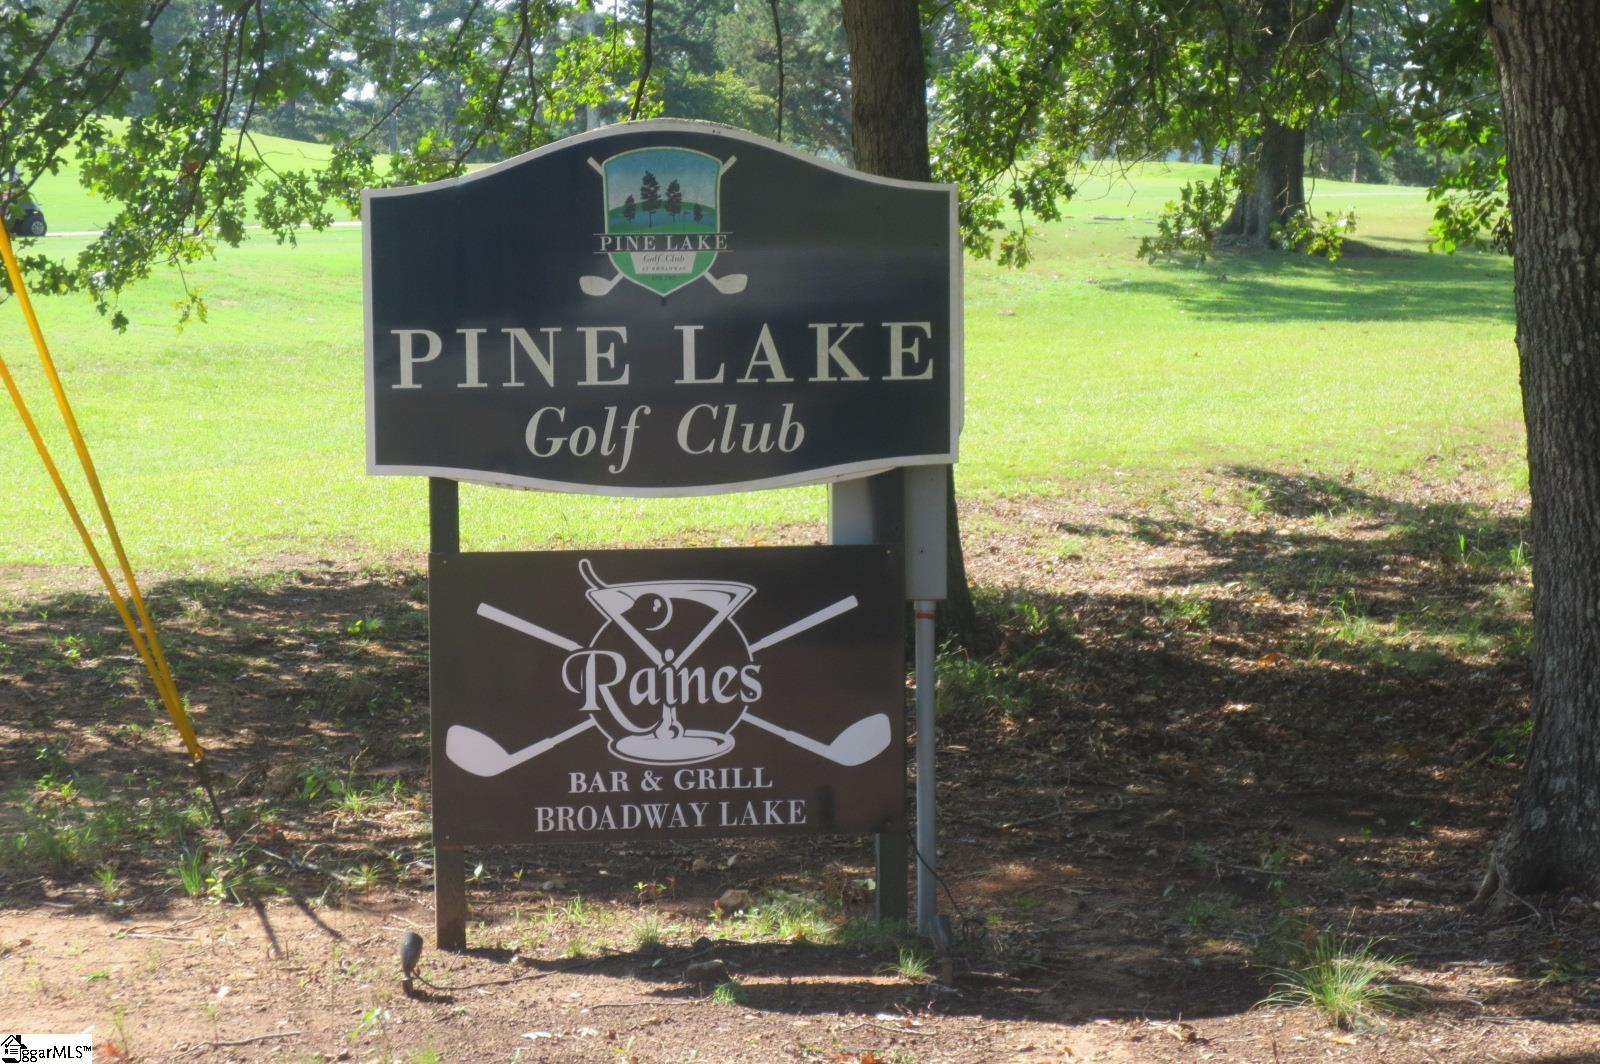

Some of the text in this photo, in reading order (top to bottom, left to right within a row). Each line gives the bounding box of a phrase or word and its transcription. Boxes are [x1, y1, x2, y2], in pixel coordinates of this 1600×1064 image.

[600, 234, 728, 251] PINE LAKE
[643, 254, 686, 264] Golf Club
[391, 321, 934, 388] PINE LAKE
[524, 403, 805, 474] Golf Club
[562, 649, 763, 733] Raines
[568, 767, 773, 794] BAR & GRILL
[534, 800, 807, 833] BROADWAY LAKE
